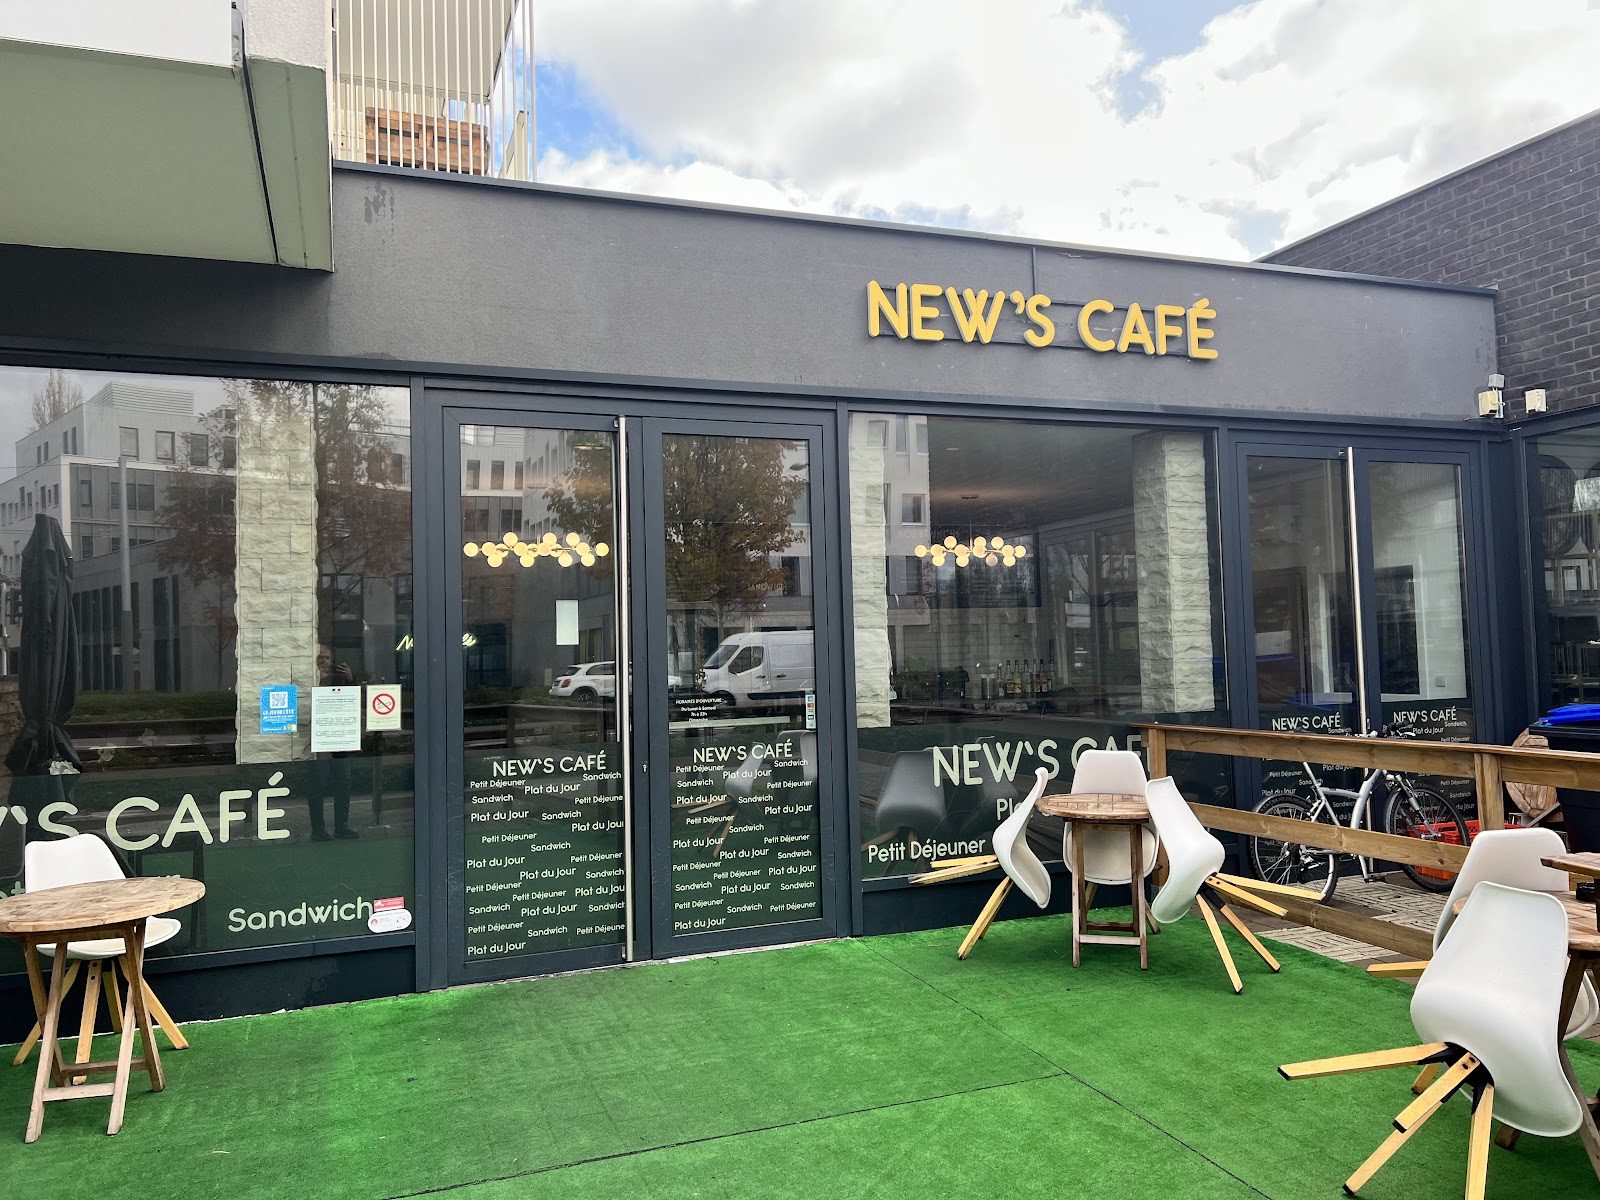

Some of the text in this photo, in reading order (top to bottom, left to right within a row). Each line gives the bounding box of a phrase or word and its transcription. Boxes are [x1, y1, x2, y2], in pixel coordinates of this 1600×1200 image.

[867, 280, 1219, 359] NEW'S CAFÉ
[1430, 706, 1457, 722] CAFÉ
[1272, 712, 1341, 730] NEW'S CAFÉ
[694, 739, 792, 764] NEW'S CAFÉ
[493, 750, 606, 777] NEW'S CAFÉ
[774, 758, 809, 768] Sandwich
[933, 739, 1060, 787] NEW'S
[693, 765, 725, 773] Déjeuner
[723, 767, 772, 780] Plat du Jour
[583, 772, 621, 781] Sandwich
[490, 779, 526, 789] Déjeuner
[677, 778, 713, 787] Sandwich
[783, 779, 812, 788] Déjeuner
[525, 783, 580, 794] Plat du Jour
[472, 794, 513, 804] Sandwich
[593, 795, 623, 803] Déjeune
[677, 794, 727, 805] Plat du Jour
[738, 794, 773, 803] Sandwich
[105, 771, 290, 851] CAFÉ
[542, 810, 581, 820] Sandwich
[765, 804, 812, 815] Plat du Jour
[471, 810, 529, 822] Plat du Jour
[703, 816, 734, 824] Déjeuner
[572, 823, 590, 832] Plat
[592, 821, 604, 830] du
[729, 824, 764, 833] Sandwich
[502, 833, 537, 842] Déjeuner
[674, 837, 724, 848] Plat du Jour
[764, 836, 779, 844] Petit
[531, 842, 570, 852] Sandwich
[868, 839, 986, 863] Petit Déjeuner
[571, 853, 622, 863] Petit Déjeuner
[720, 848, 769, 859] Plat du Jour
[778, 850, 811, 859] Sandwich
[467, 856, 525, 868] Plat du Jour
[690, 862, 721, 870] Déjeuner
[520, 868, 576, 880] Plat du Jour
[586, 869, 624, 879] Sandwich
[730, 870, 761, 878] Déjeuner
[769, 865, 816, 876] Plat du Jour
[466, 882, 521, 893] Petit Déjeuner
[575, 885, 625, 896] Plat du Jou
[676, 881, 712, 891] Sandwich
[722, 883, 771, 894] Plat du Jour
[781, 881, 814, 890] Sandwich
[513, 891, 566, 901] Petit Déjeuner
[469, 903, 510, 914] Sandwich
[692, 899, 723, 908] Déjeuner
[727, 903, 762, 913] Sandwich
[770, 902, 816, 912] Petit Déjeuner
[228, 896, 374, 933] Sandwich
[522, 904, 577, 917] Plat du Jour
[488, 922, 524, 932] Déjeuner
[577, 924, 625, 935] Petit Déjeune
[675, 918, 726, 930] Plat du Jour
[528, 926, 567, 937] Sandwich
[468, 942, 526, 955] Plat du Jour
